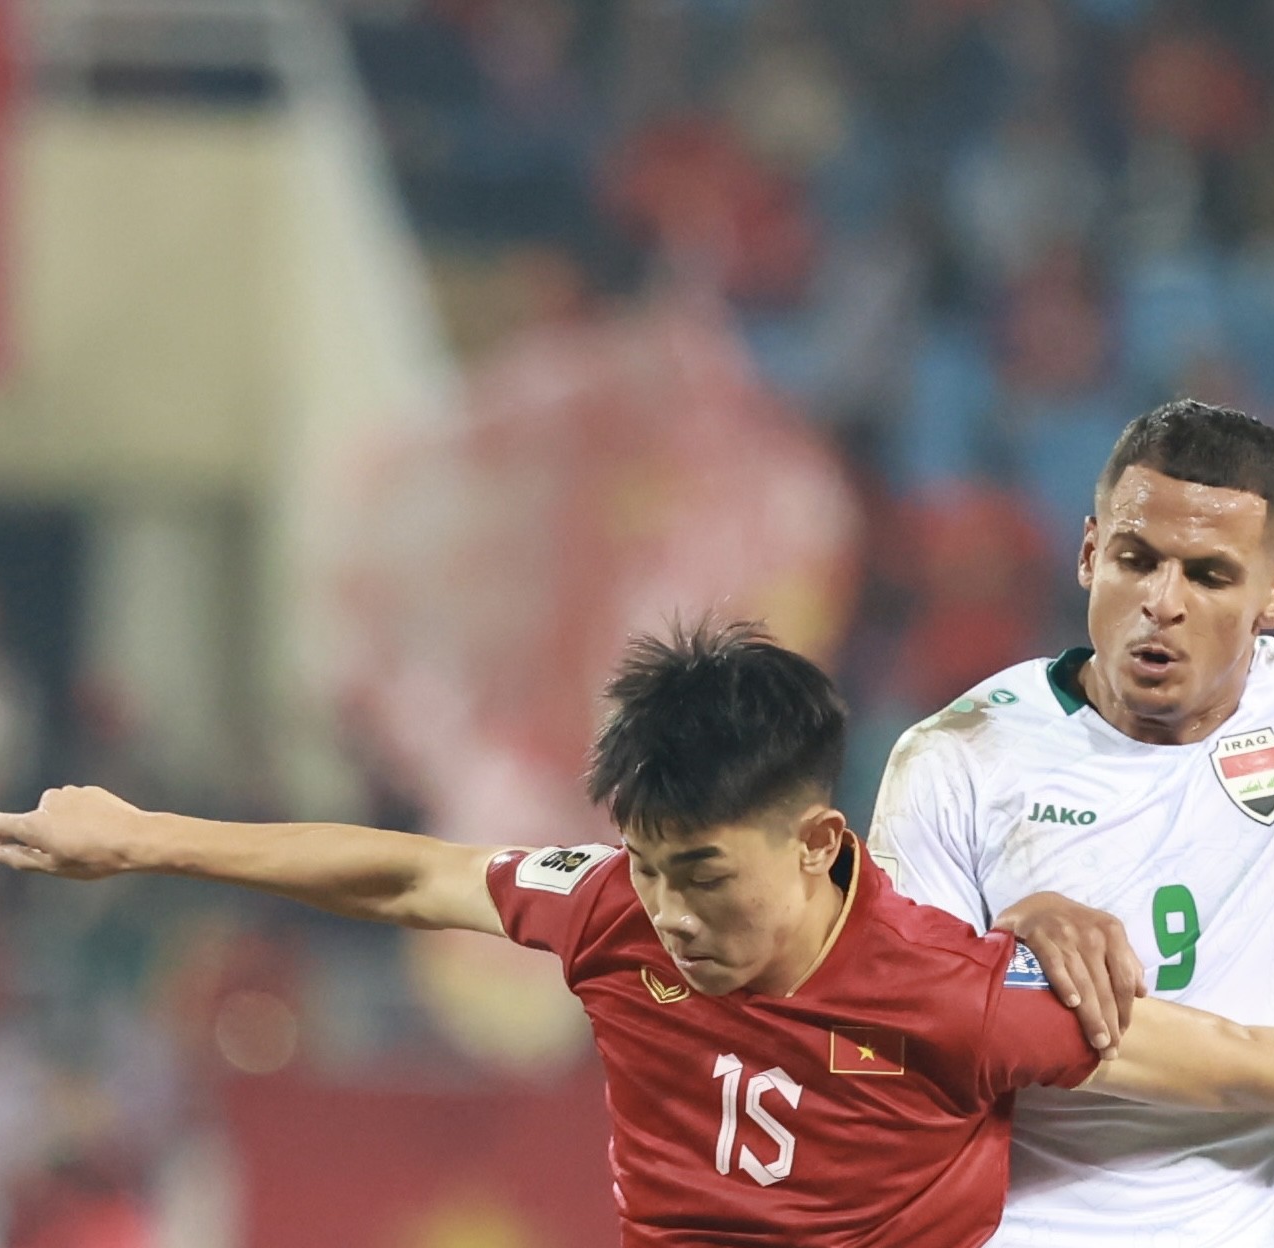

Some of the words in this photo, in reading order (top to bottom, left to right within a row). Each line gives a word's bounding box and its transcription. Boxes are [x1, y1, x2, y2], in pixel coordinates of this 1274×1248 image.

[1224, 735, 1269, 752] IRAQ
[1027, 802, 1097, 826] JAKO
[1152, 884, 1201, 991] 9
[712, 1053, 803, 1187] 15
